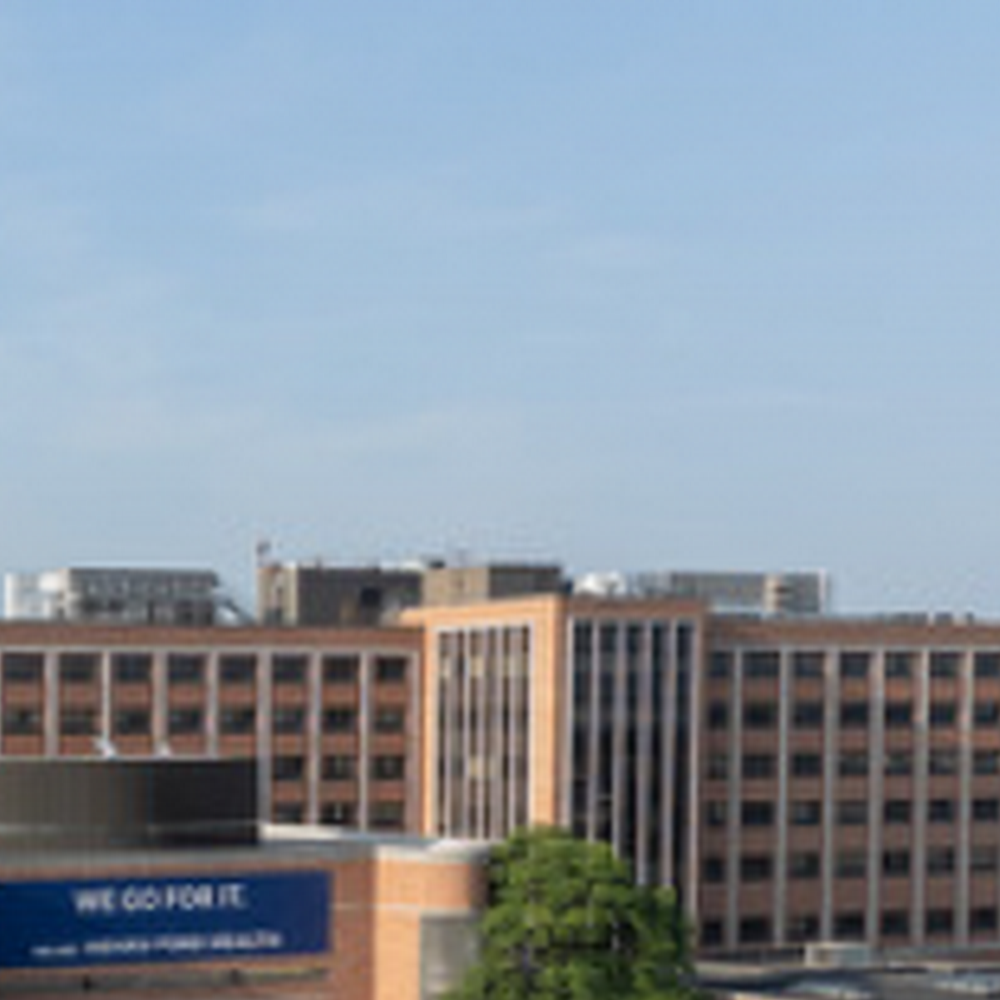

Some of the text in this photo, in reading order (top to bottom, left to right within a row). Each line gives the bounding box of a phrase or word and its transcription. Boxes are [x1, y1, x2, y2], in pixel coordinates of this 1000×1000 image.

[72, 887, 114, 912] WE
[122, 886, 161, 910] GO
[167, 885, 213, 909] FOR
